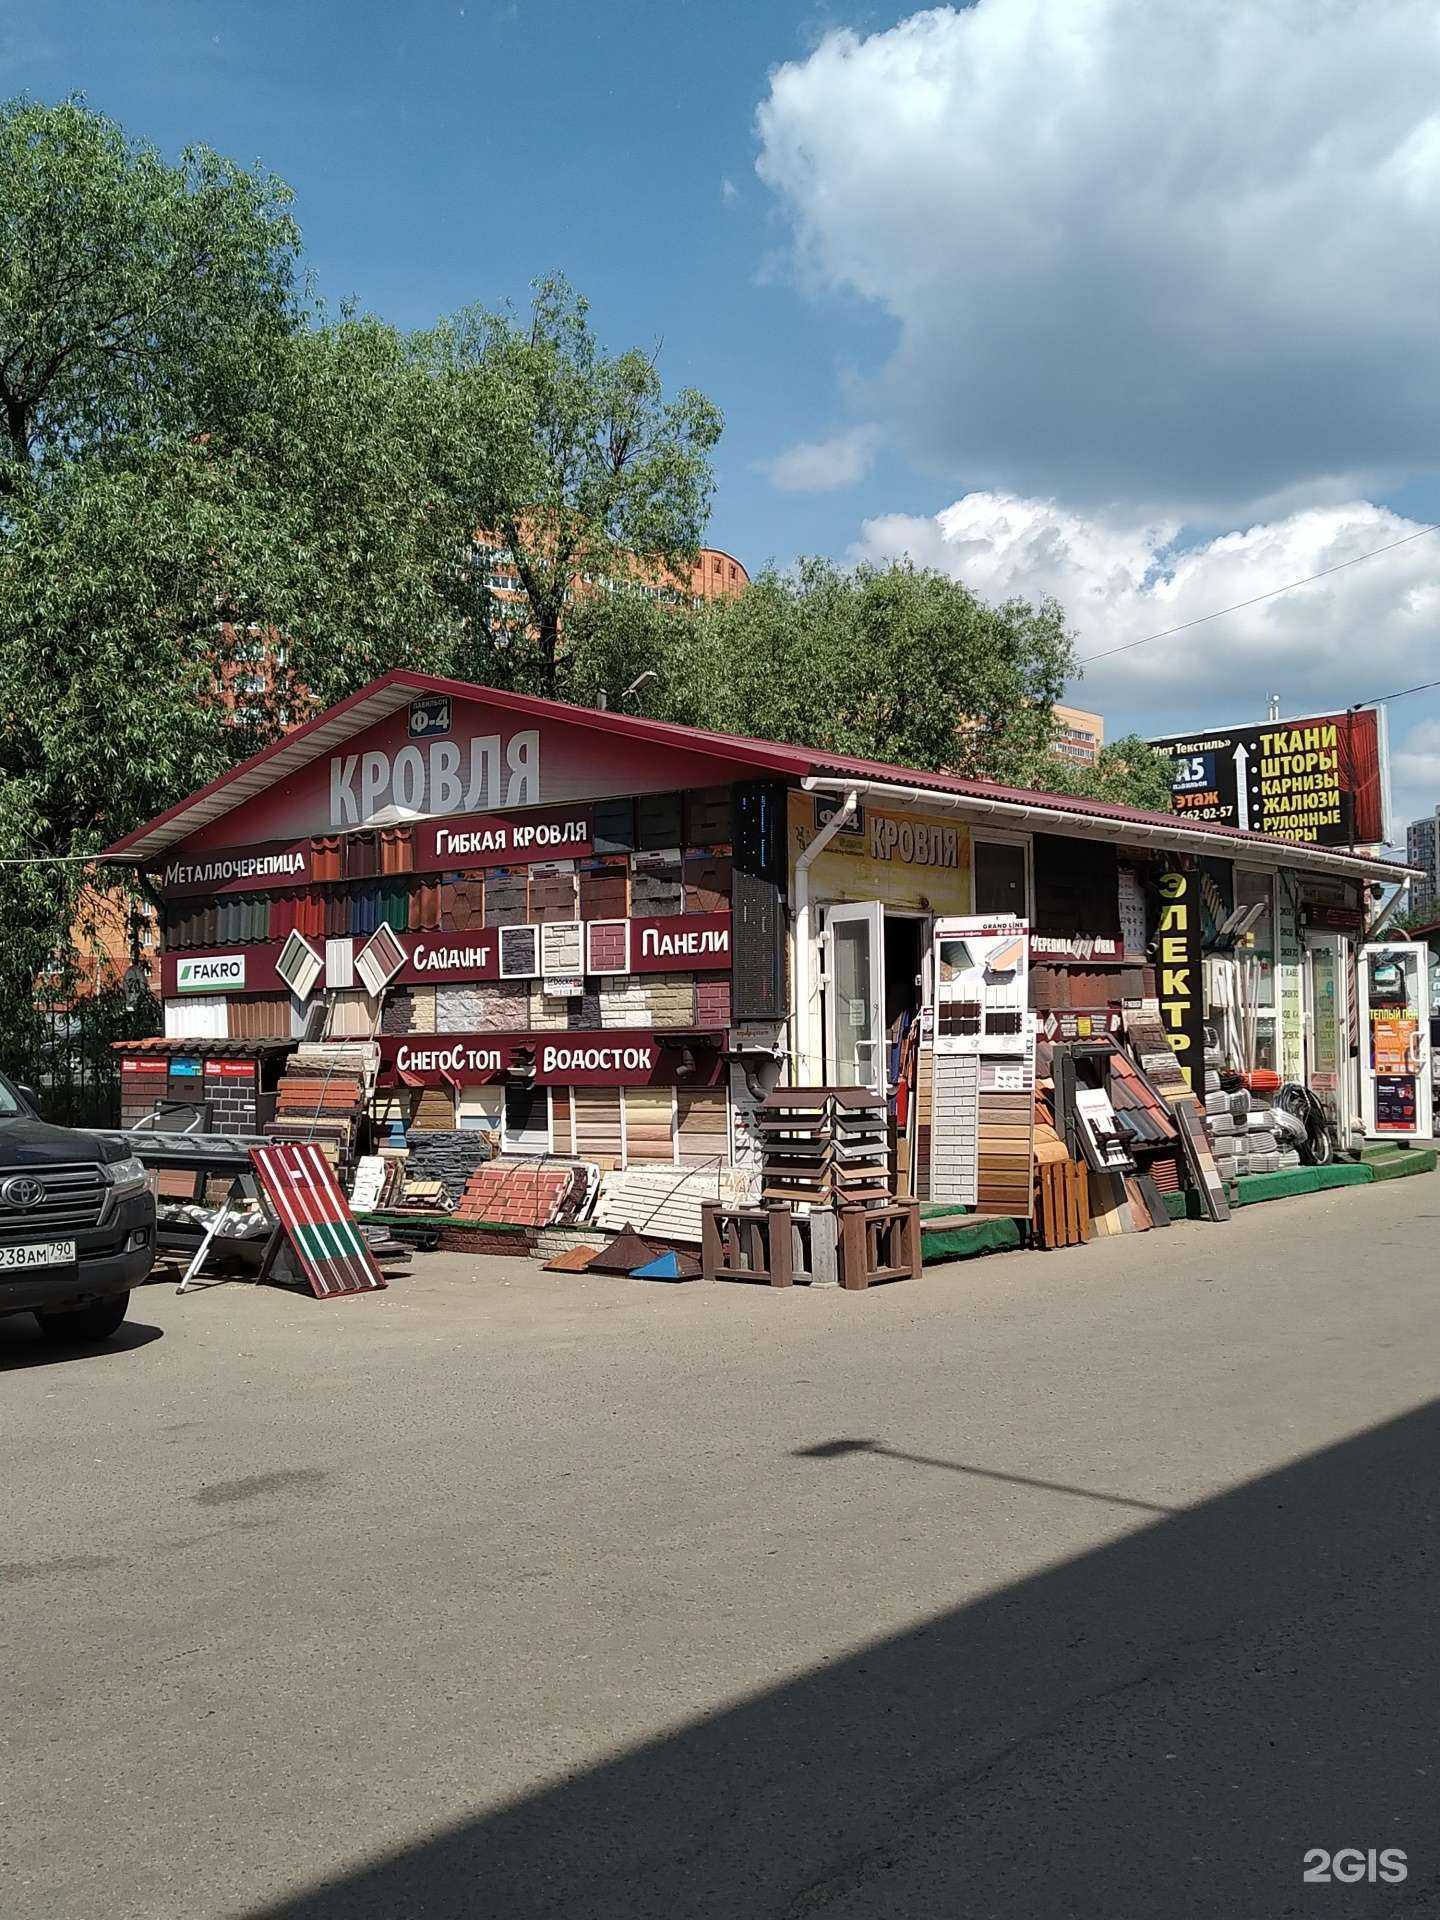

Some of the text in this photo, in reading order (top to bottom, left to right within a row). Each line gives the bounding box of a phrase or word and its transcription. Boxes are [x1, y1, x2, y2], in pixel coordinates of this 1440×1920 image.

[411, 706, 449, 732] Ф-4
[1175, 739, 1231, 754] Текстиль»
[1260, 725, 1337, 756] ТКАНИ
[1176, 757, 1205, 782] А5
[1261, 750, 1338, 778] ШТОРЫ
[331, 730, 540, 826] КРОВЛЯ
[1261, 772, 1339, 796] КАРНИЗЫ
[1175, 791, 1219, 809] этаж
[1263, 790, 1340, 815] ЖАЛЮЗИ
[1263, 810, 1341, 832] РУЛОННЫЕ
[870, 815, 959, 868] КРОВЛЯ
[193, 962, 240, 980] FAKRO
[1370, 1006, 1401, 1020] ТЕПЛЫЙ
[49, 1242, 71, 1257] 790
